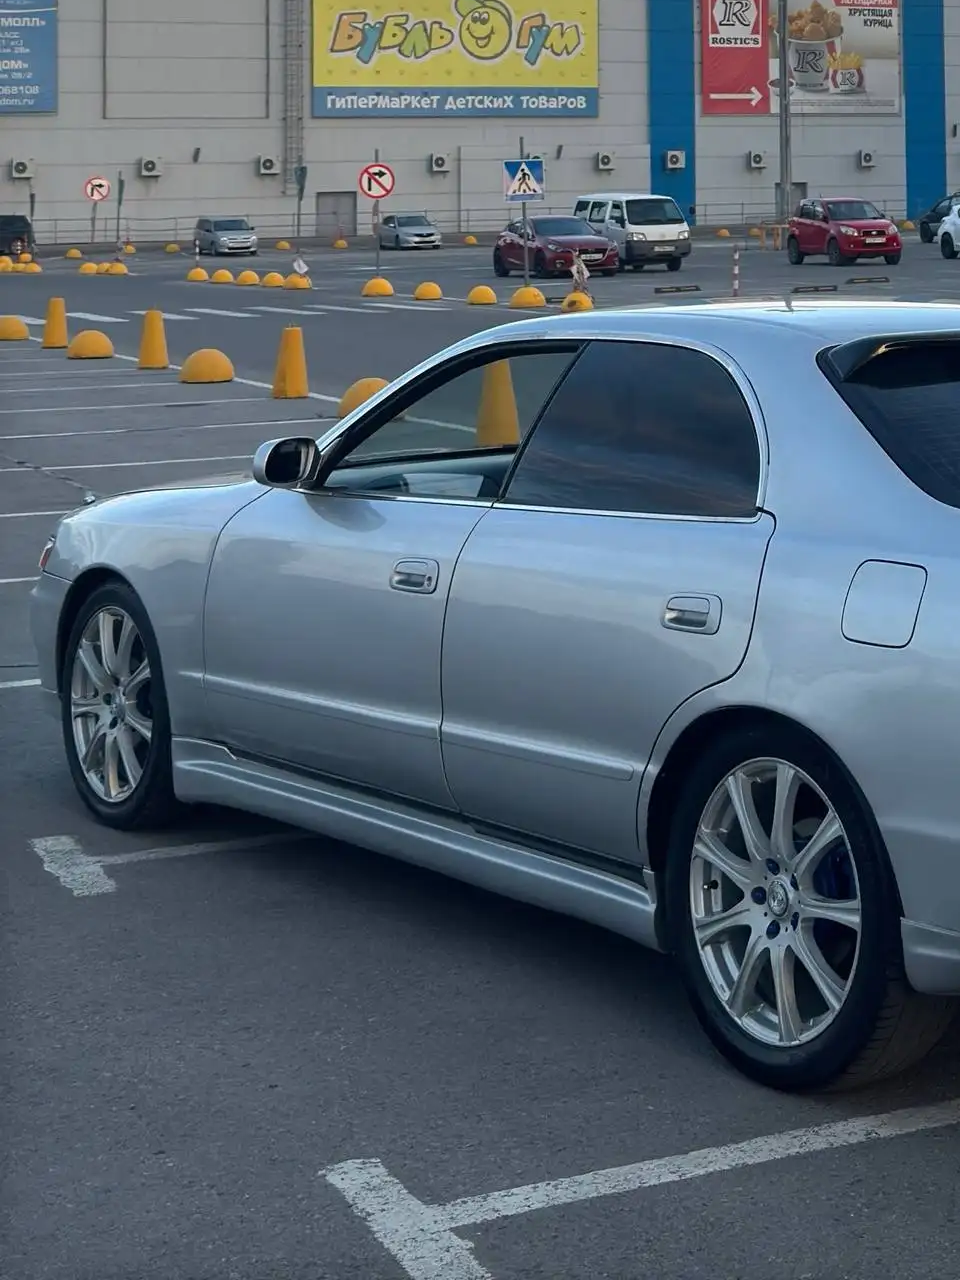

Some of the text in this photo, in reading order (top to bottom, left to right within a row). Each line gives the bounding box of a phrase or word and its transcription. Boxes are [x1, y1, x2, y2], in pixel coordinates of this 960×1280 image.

[848, 7, 893, 18] ХРУСТЯЩАЯ
[863, 19, 893, 29] КУРИЦА
[711, 36, 760, 46] ROSTIC'S
